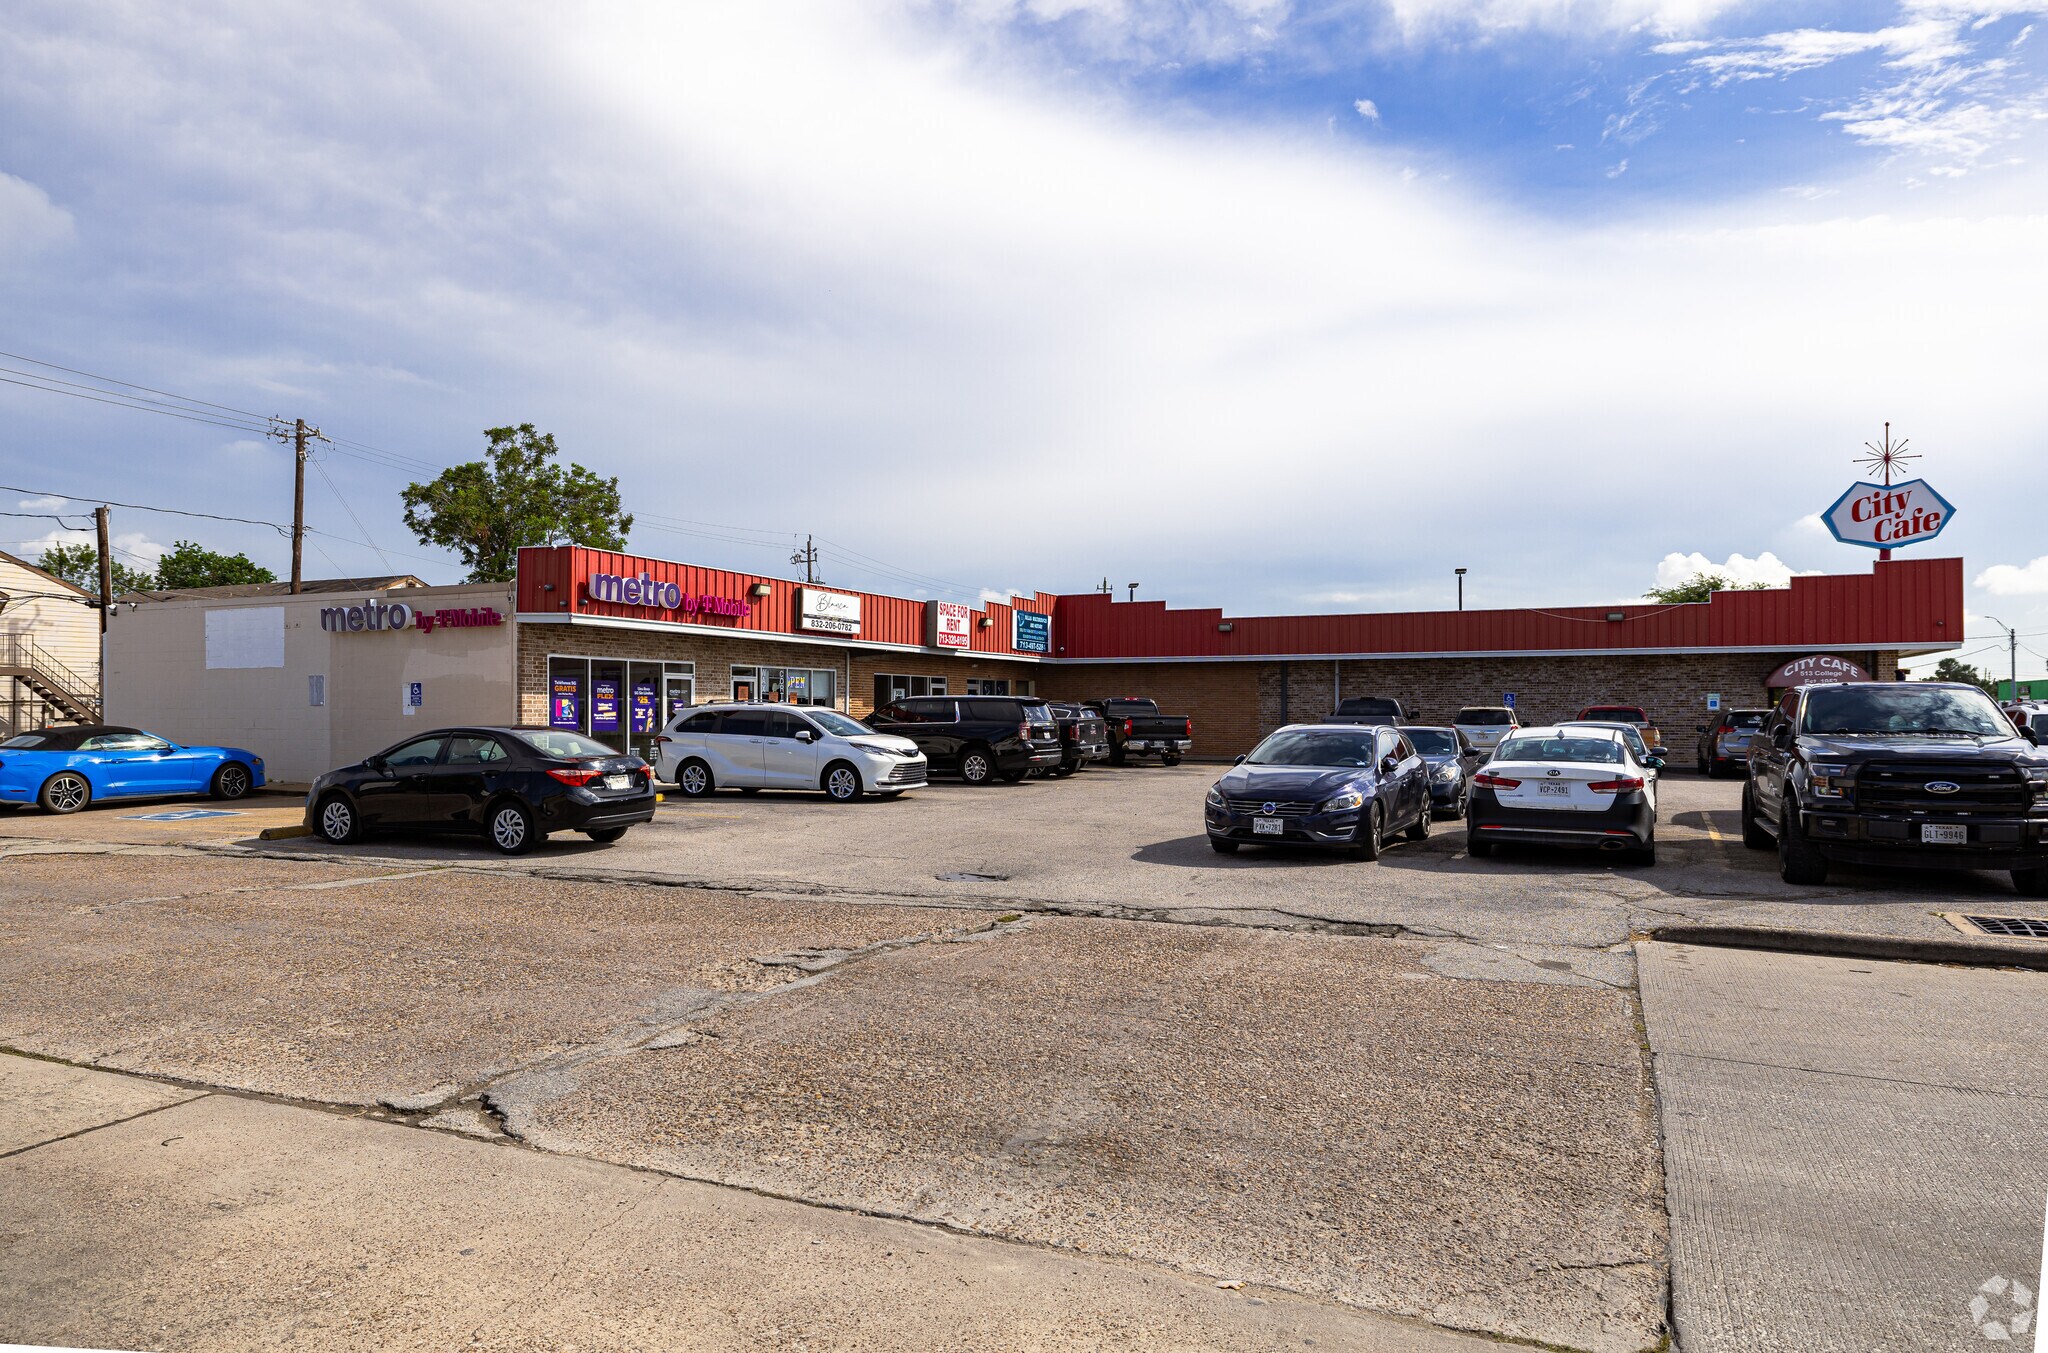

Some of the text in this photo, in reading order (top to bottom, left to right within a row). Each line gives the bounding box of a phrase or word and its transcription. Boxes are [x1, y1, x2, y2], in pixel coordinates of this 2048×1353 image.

[1851, 489, 1913, 523] City
[1874, 507, 1941, 543] Cafe
[592, 572, 682, 609] metro
[684, 593, 700, 616] by
[321, 599, 410, 632] metro
[415, 610, 435, 633] by
[939, 602, 969, 619] SPACE FOR
[810, 619, 853, 631] 832-206-0782
[946, 618, 961, 632] RENT
[1783, 657, 1858, 678] CITY CAFE
[1814, 670, 1843, 678] College
[554, 685, 577, 693] GRATIS
[1932, 783, 1952, 791] Ford
